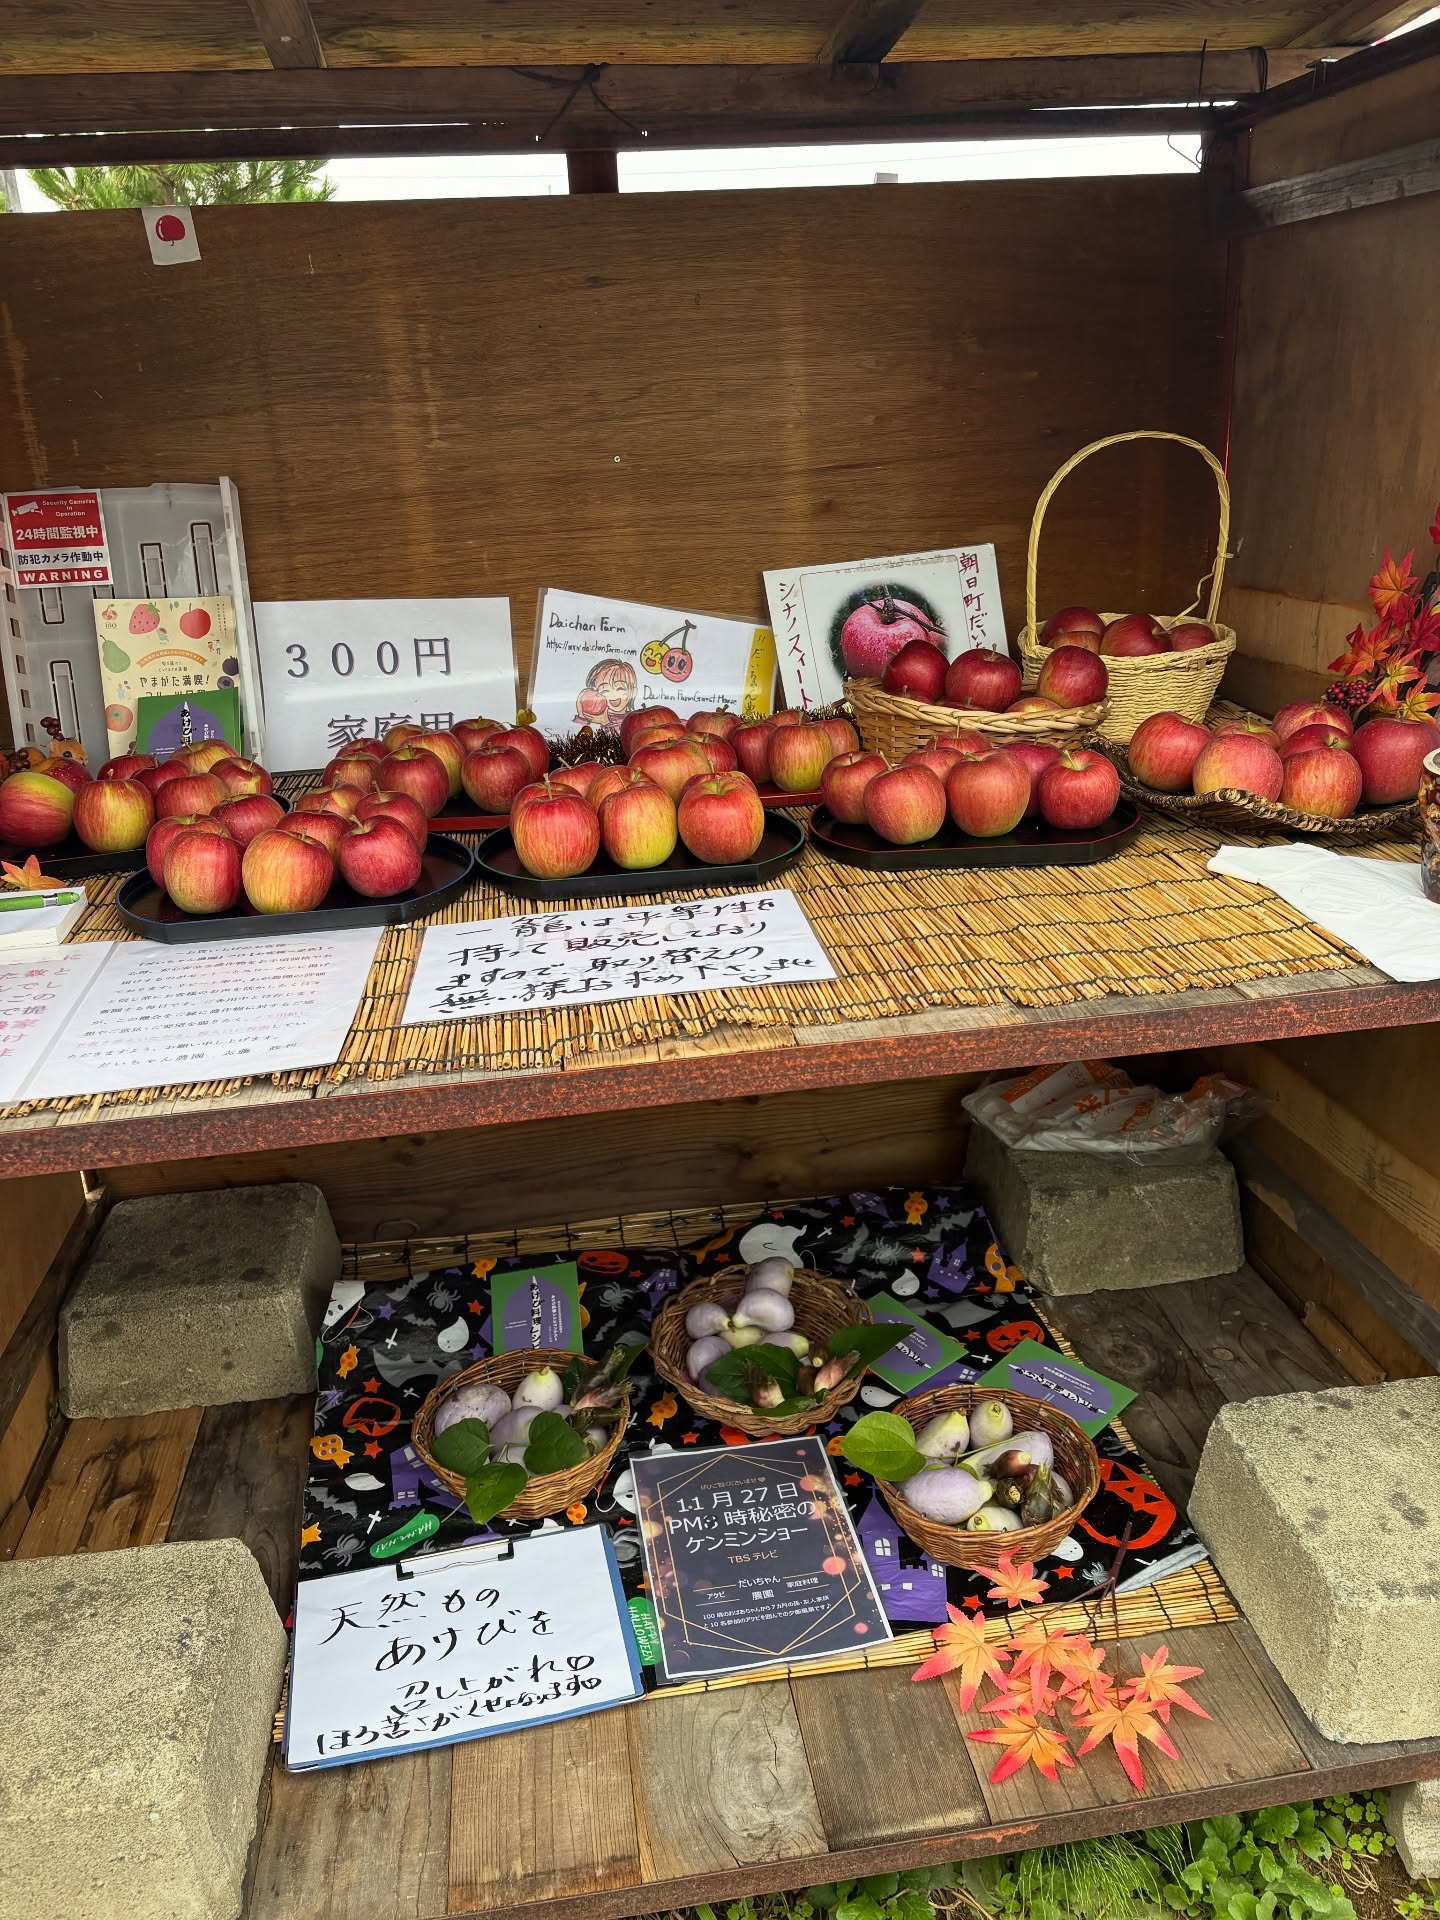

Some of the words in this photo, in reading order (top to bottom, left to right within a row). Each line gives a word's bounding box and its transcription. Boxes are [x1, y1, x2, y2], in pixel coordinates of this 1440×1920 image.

[16, 525, 99, 540] 24時間監視中
[18, 551, 104, 565] 防犯カメラ作動中
[23, 569, 103, 582] WARNING
[549, 612, 596, 631] Daichan
[600, 617, 626, 633] Farm
[685, 1527, 808, 1554] ケンミンショー
[738, 1575, 781, 1588] だいちゃん
[317, 1587, 500, 1646] 天然もの
[375, 1609, 555, 1672] あけびを
